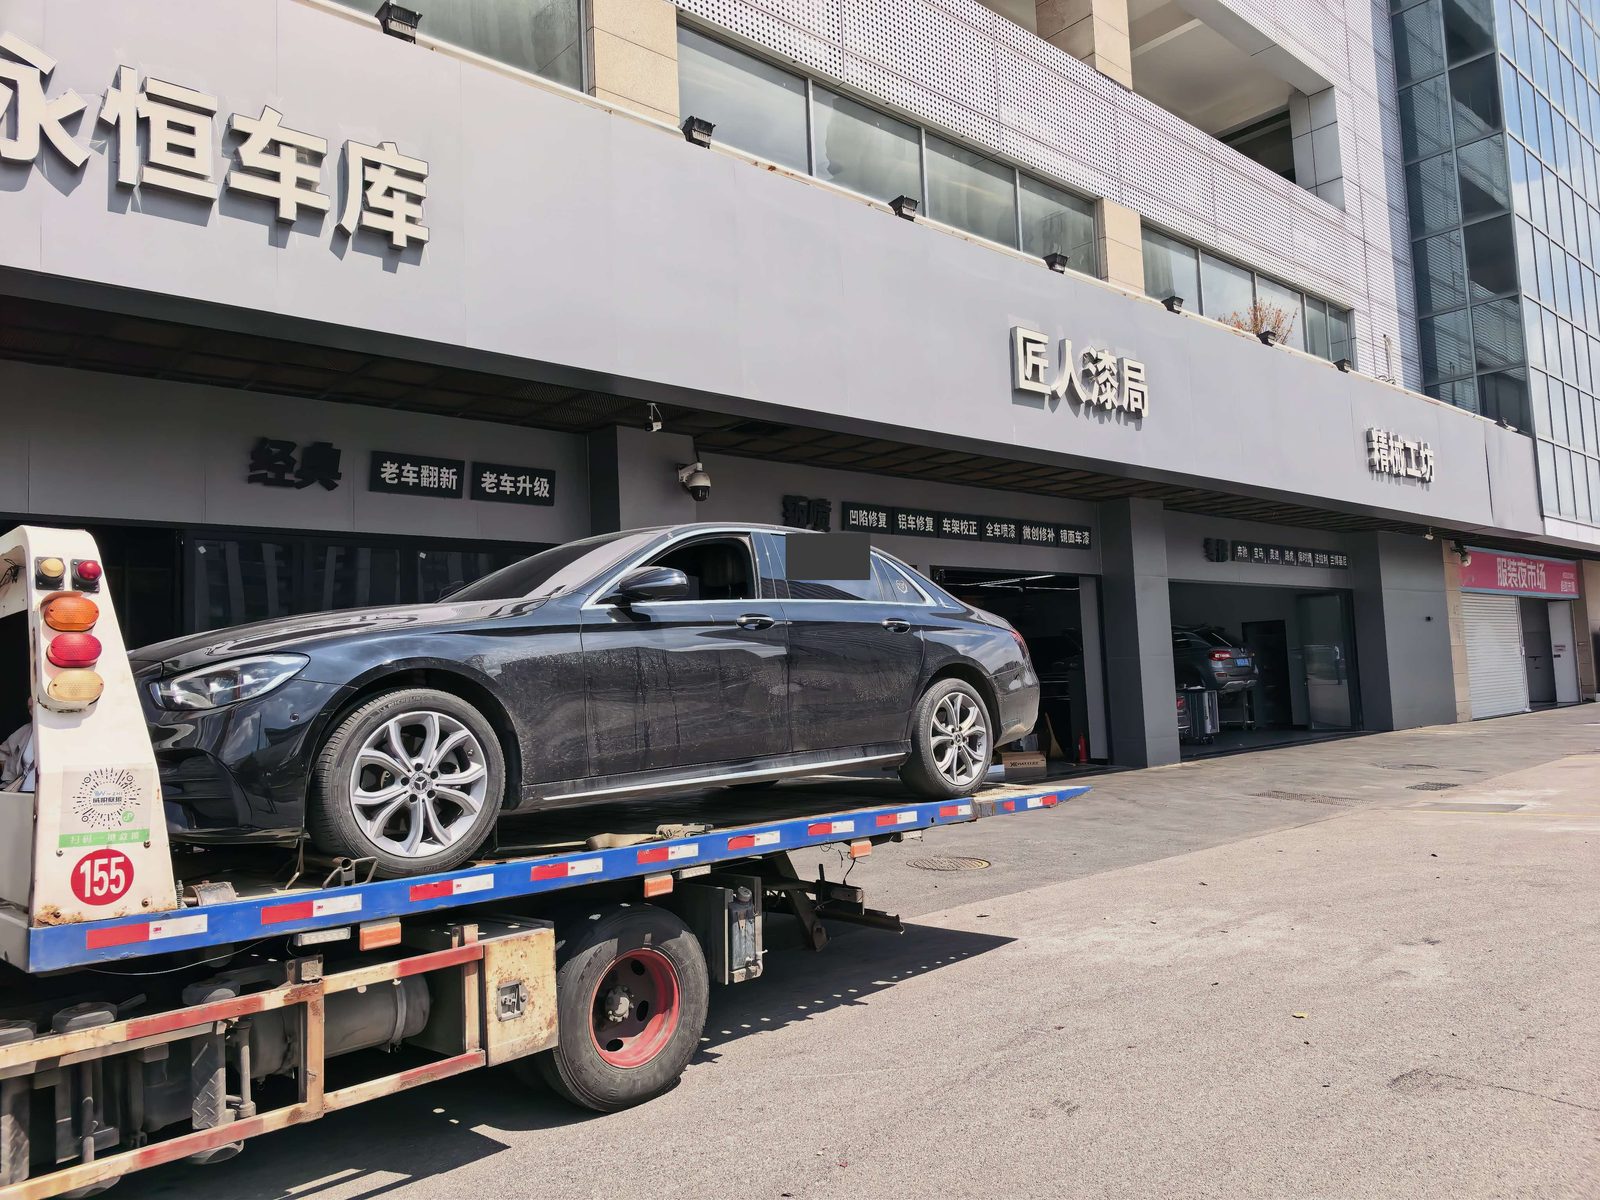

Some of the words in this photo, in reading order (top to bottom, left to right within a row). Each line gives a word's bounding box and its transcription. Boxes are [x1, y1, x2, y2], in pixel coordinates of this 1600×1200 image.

[0, 31, 429, 249] 永恒车库
[1011, 326, 1149, 418] 匠人漆局
[380, 461, 458, 490] 老车翻新
[481, 471, 550, 499] 老车升级
[849, 510, 887, 528] 凹陷修复
[898, 514, 934, 532] 铝车修复
[942, 518, 978, 536] 车架校正
[985, 522, 1016, 539] 全车喷漆
[80, 856, 126, 898] 155
